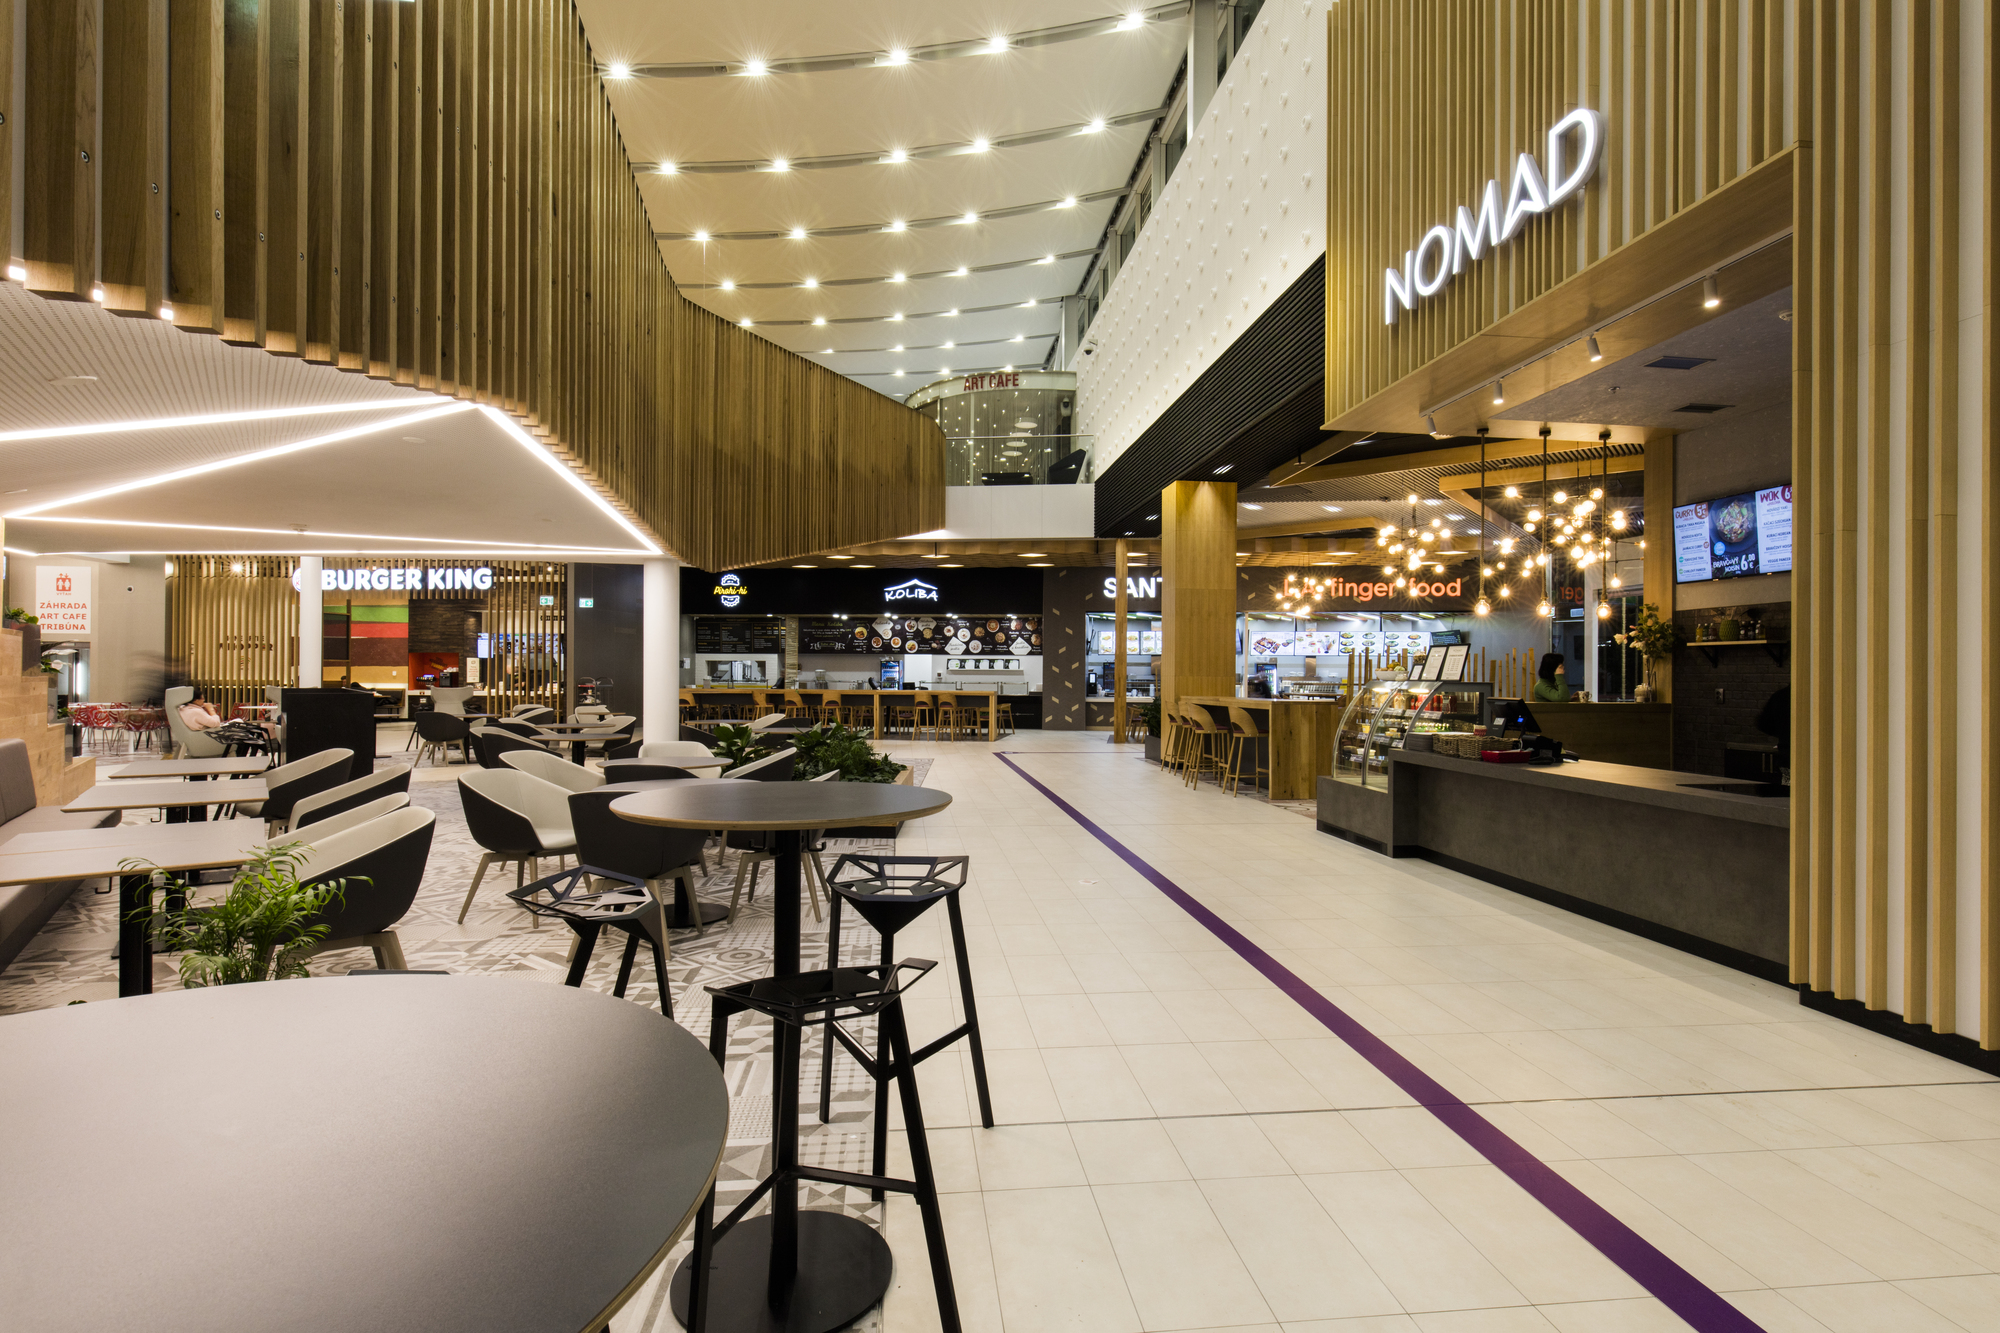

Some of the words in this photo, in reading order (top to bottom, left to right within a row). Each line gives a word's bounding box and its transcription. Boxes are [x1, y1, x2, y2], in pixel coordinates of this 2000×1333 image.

[1385, 108, 1604, 325] NOMAD
[963, 376, 985, 391] ART
[989, 373, 1019, 389] CAFE
[1760, 490, 1779, 503] WOK
[1675, 508, 1694, 519] CURRY
[321, 568, 422, 591] BURGER
[427, 567, 493, 590] KING
[885, 588, 938, 601] KOLIBA
[1330, 577, 1396, 602] finger
[1409, 577, 1462, 597] food
[40, 600, 87, 609] ZÁHRADA
[41, 621, 86, 631] TRIBÚNA
